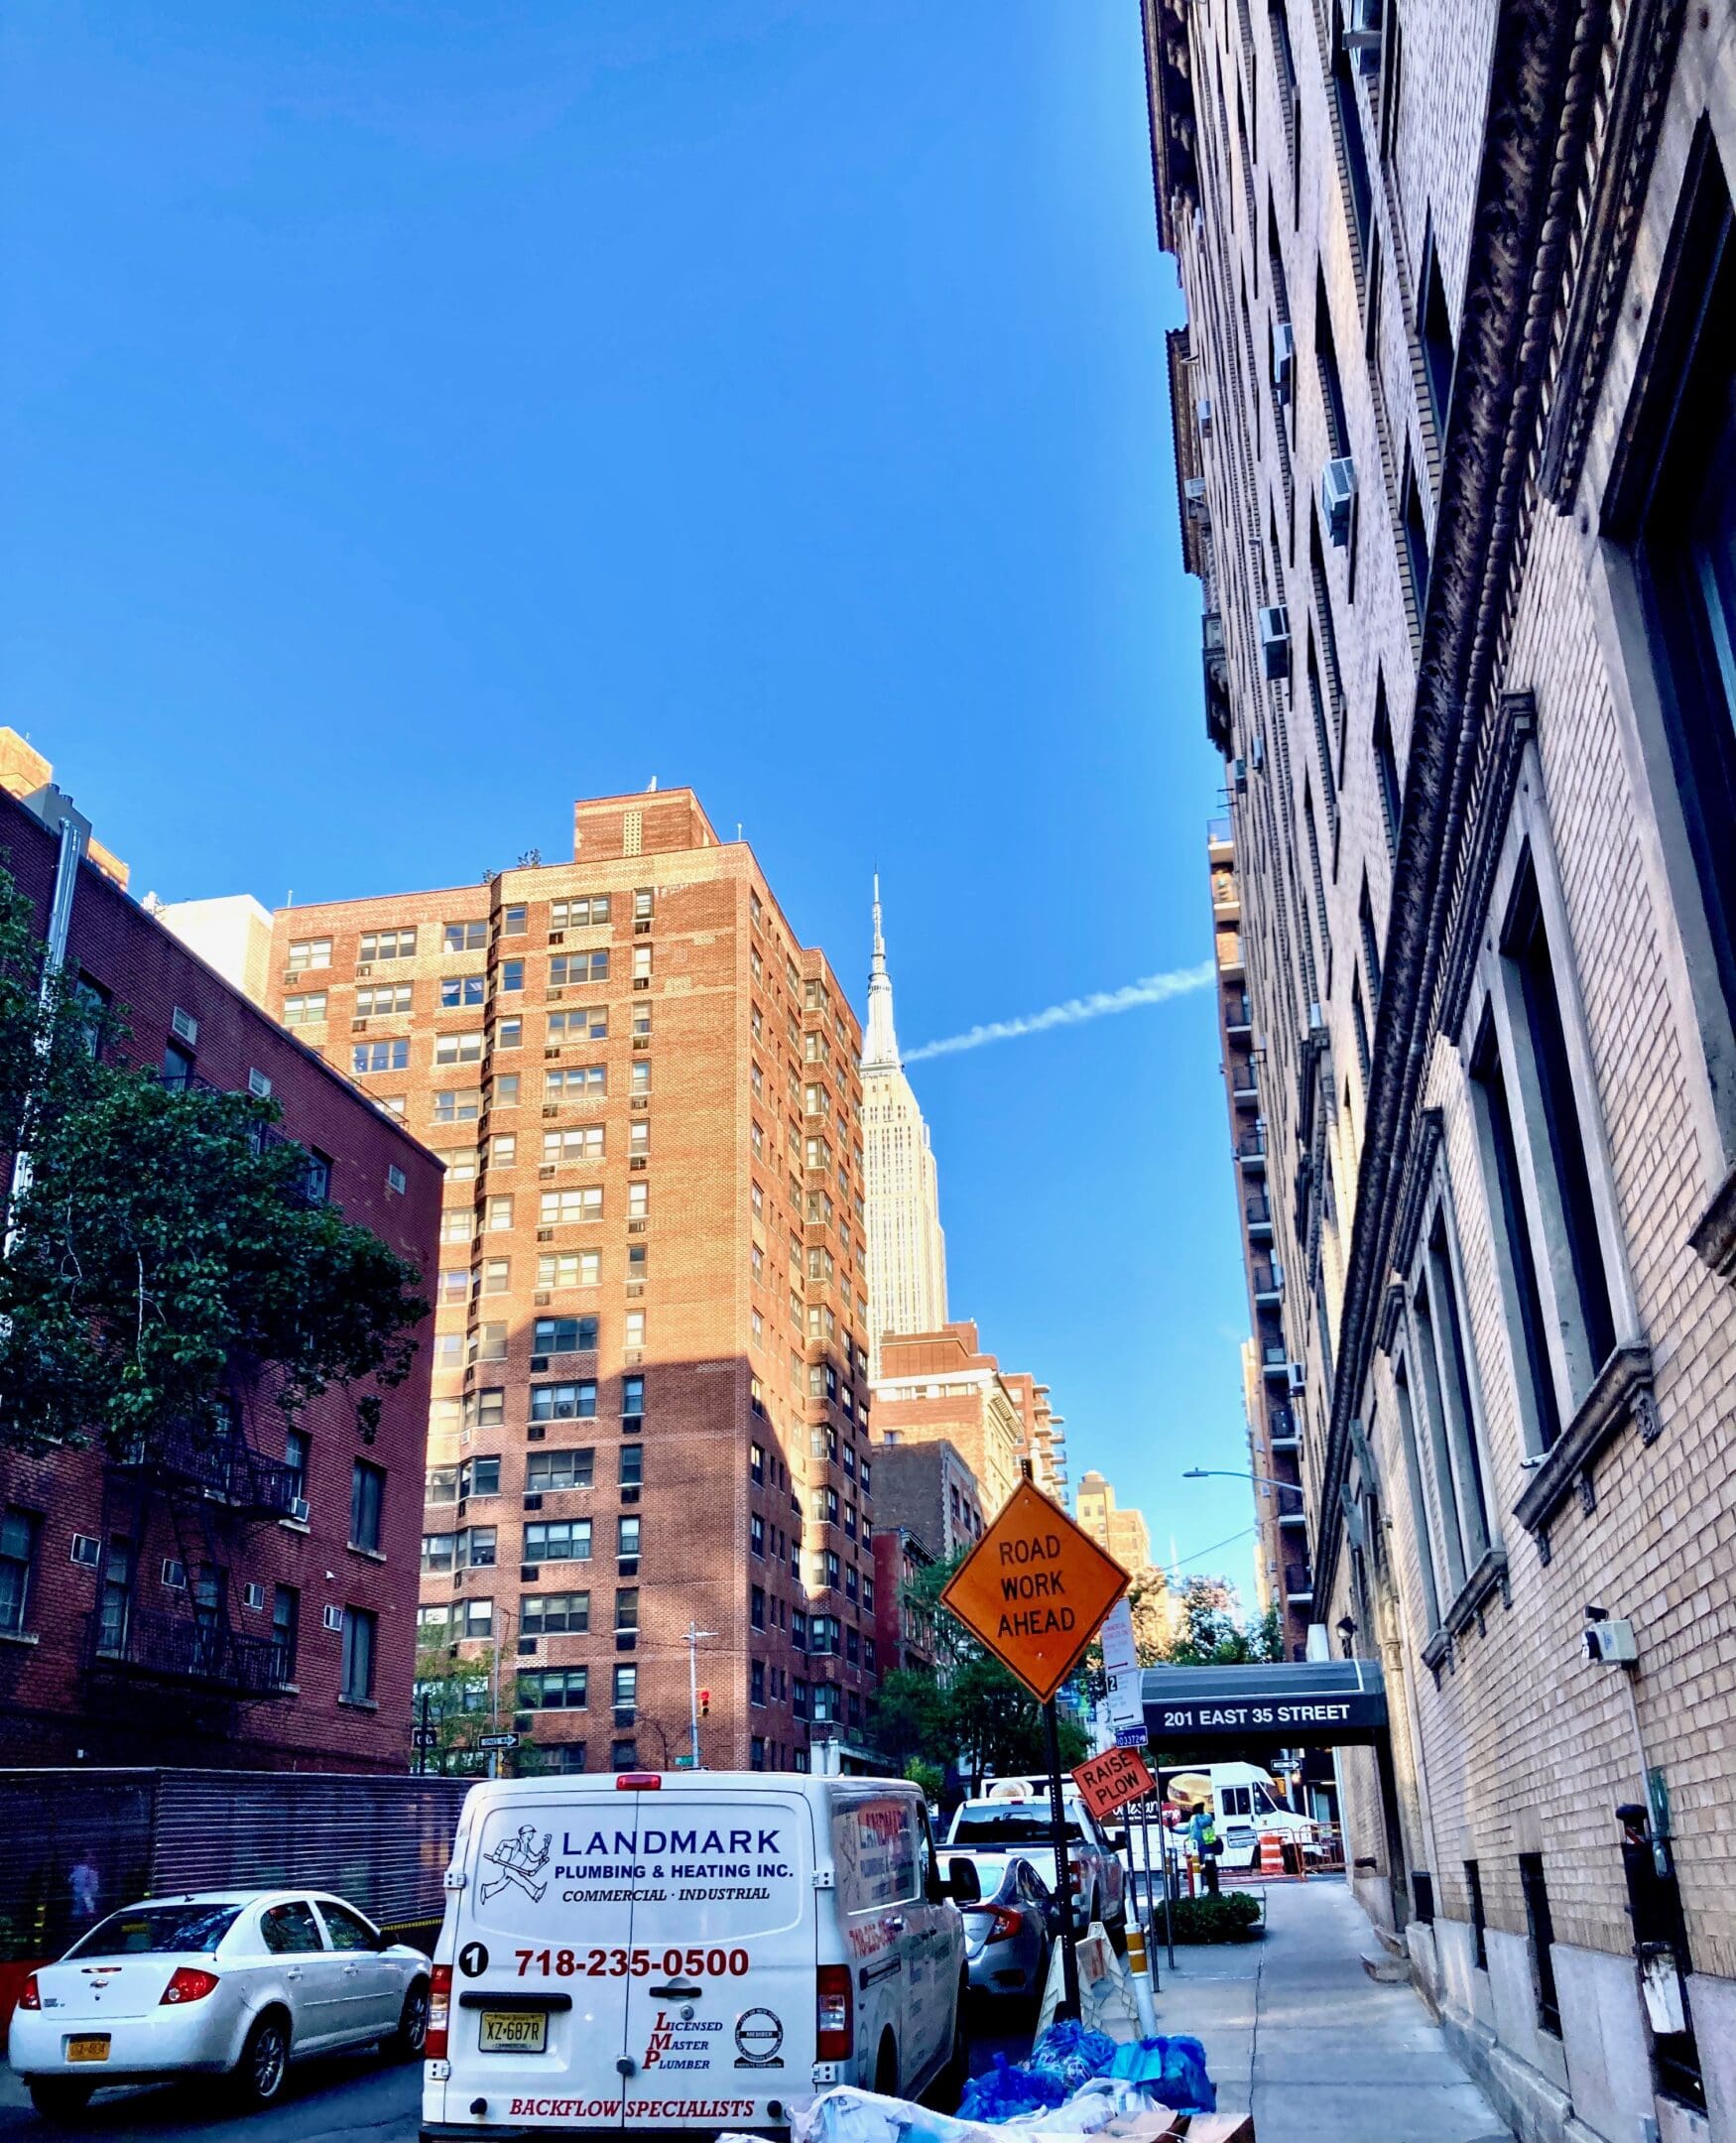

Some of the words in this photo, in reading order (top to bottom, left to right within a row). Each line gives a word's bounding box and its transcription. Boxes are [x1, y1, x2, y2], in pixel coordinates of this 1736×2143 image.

[999, 1535, 1060, 1566] ROAD
[1001, 1570, 1065, 1601] WORK
[997, 1607, 1075, 1638] AHEAD
[1164, 1711, 1193, 1726] 201
[1199, 1708, 1248, 1725] EAST
[1252, 1707, 1274, 1723] 35
[1277, 1704, 1350, 1721] STREET
[1082, 1752, 1133, 1788] RAISE
[1095, 1770, 1140, 1806] PLOW
[562, 1829, 781, 1855] LANDMARK
[555, 1864, 646, 1879] PLUMBING
[652, 1865, 665, 1878] &
[671, 1864, 751, 1878] HEATING
[757, 1863, 794, 1878] INC.
[561, 1889, 667, 1902] COMMERCIAL
[679, 1888, 770, 1901] INDUSTRIAL
[465, 1947, 480, 1972] 1
[515, 1949, 749, 1976] 718-235-0500
[654, 2012, 723, 2031] LICENSED
[648, 2033, 709, 2050] MASTER
[642, 2050, 711, 2070] PLUMBER
[509, 2098, 623, 2117] BACKFLOW
[624, 2099, 755, 2117] SPECIALISTS
